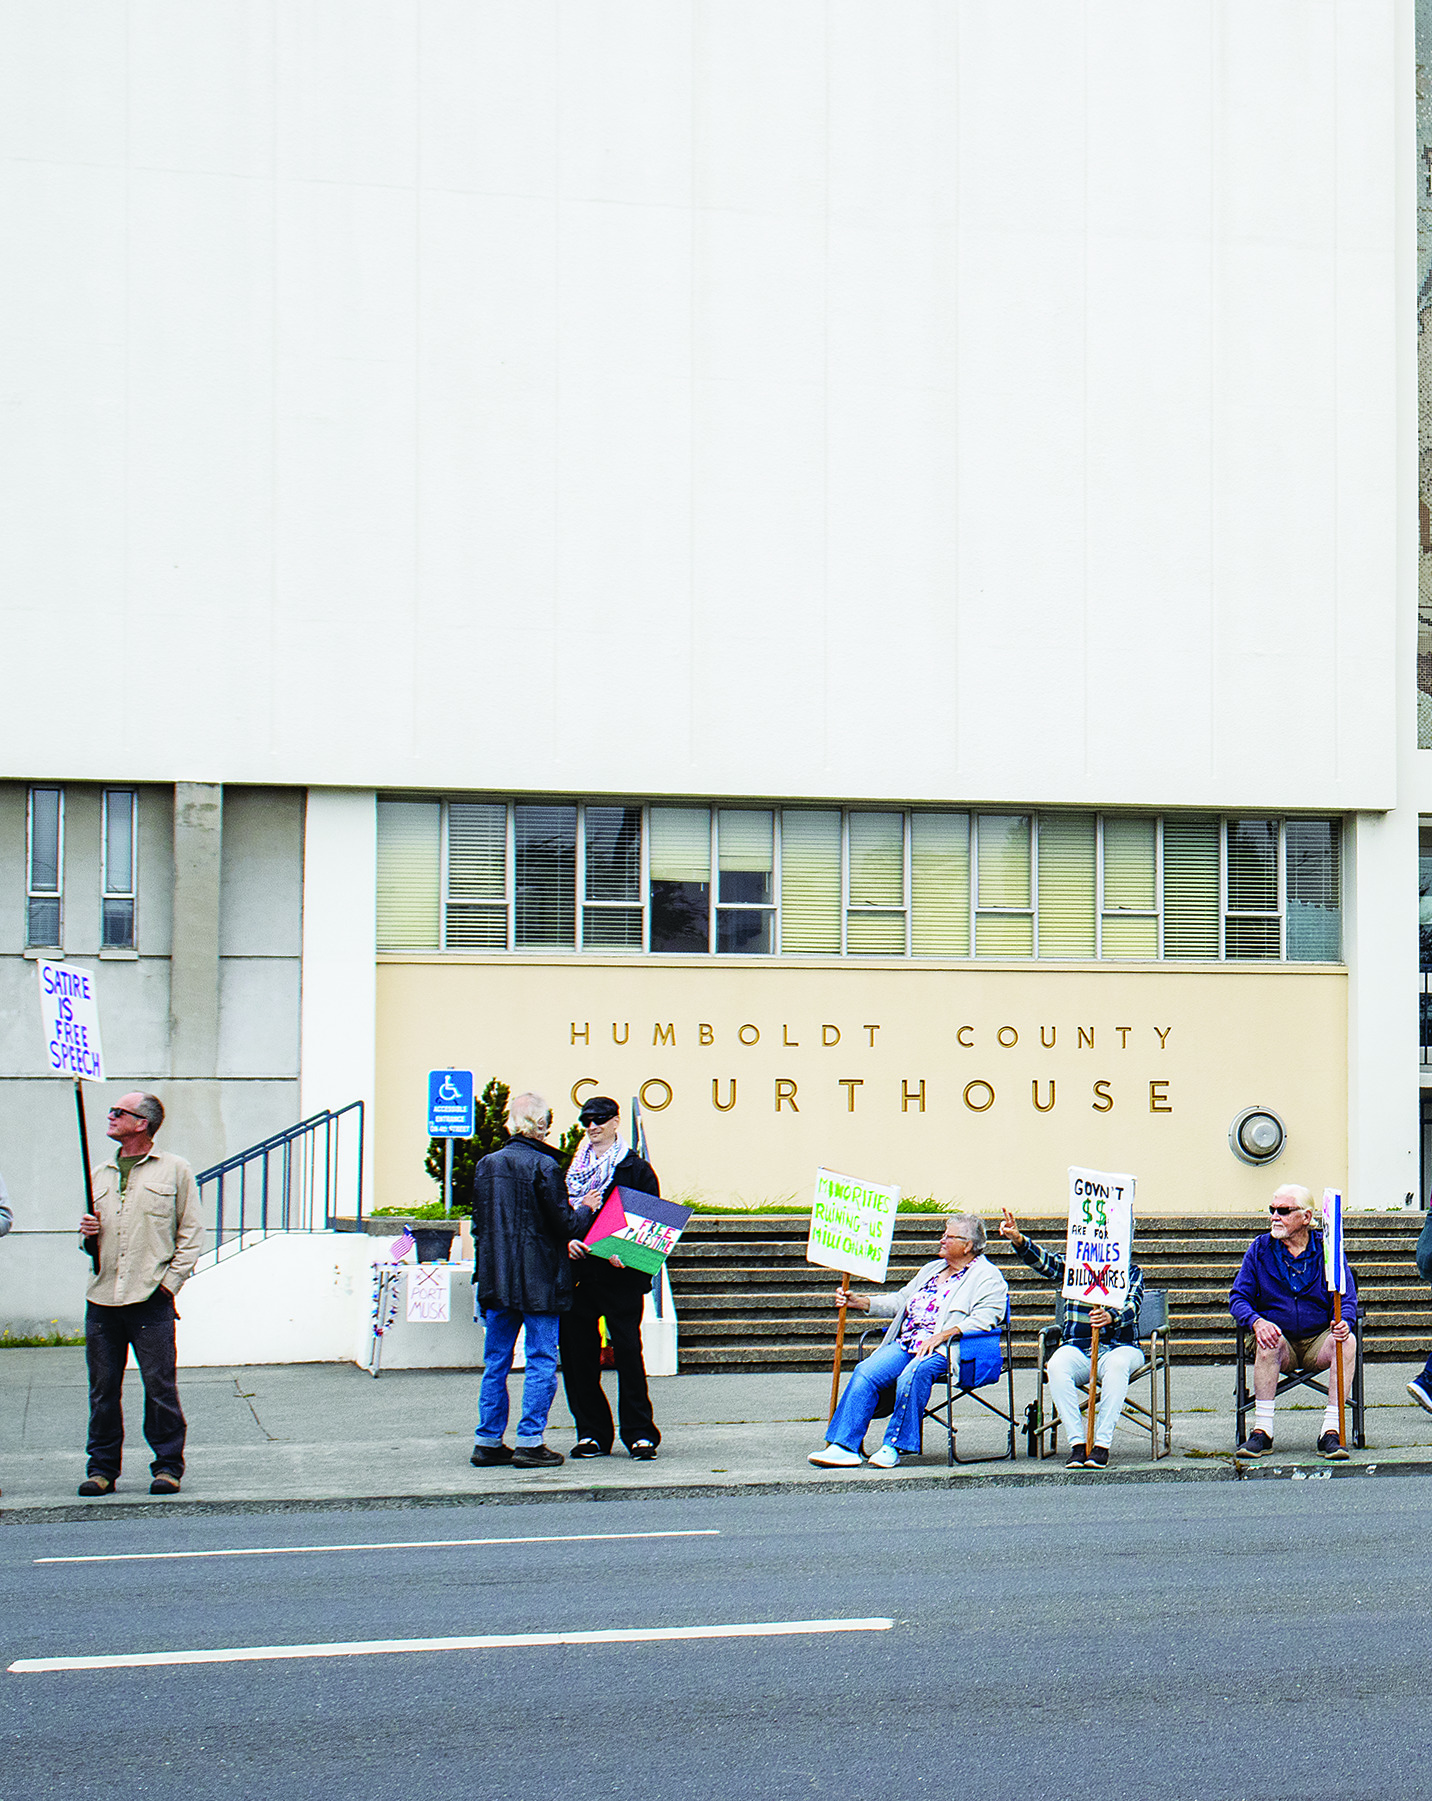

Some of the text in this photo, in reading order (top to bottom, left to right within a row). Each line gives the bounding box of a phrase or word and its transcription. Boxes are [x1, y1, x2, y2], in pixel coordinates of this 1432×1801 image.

[43, 966, 91, 1000] SATIRE
[58, 997, 73, 1022] IS
[55, 1019, 88, 1048] FREE
[570, 1022, 1172, 1049] HUMBOLDT COUNTY
[50, 1040, 100, 1077] SPEECH
[570, 1077, 1173, 1113] COURTHOUSE
[818, 1177, 891, 1214] MINORITIES
[624, 1227, 674, 1254] PALESTINE
[639, 1220, 676, 1240] FREE
[1071, 1224, 1109, 1239] ARE FOR
[410, 1287, 447, 1299] PORT
[408, 1302, 447, 1320] MUSK
